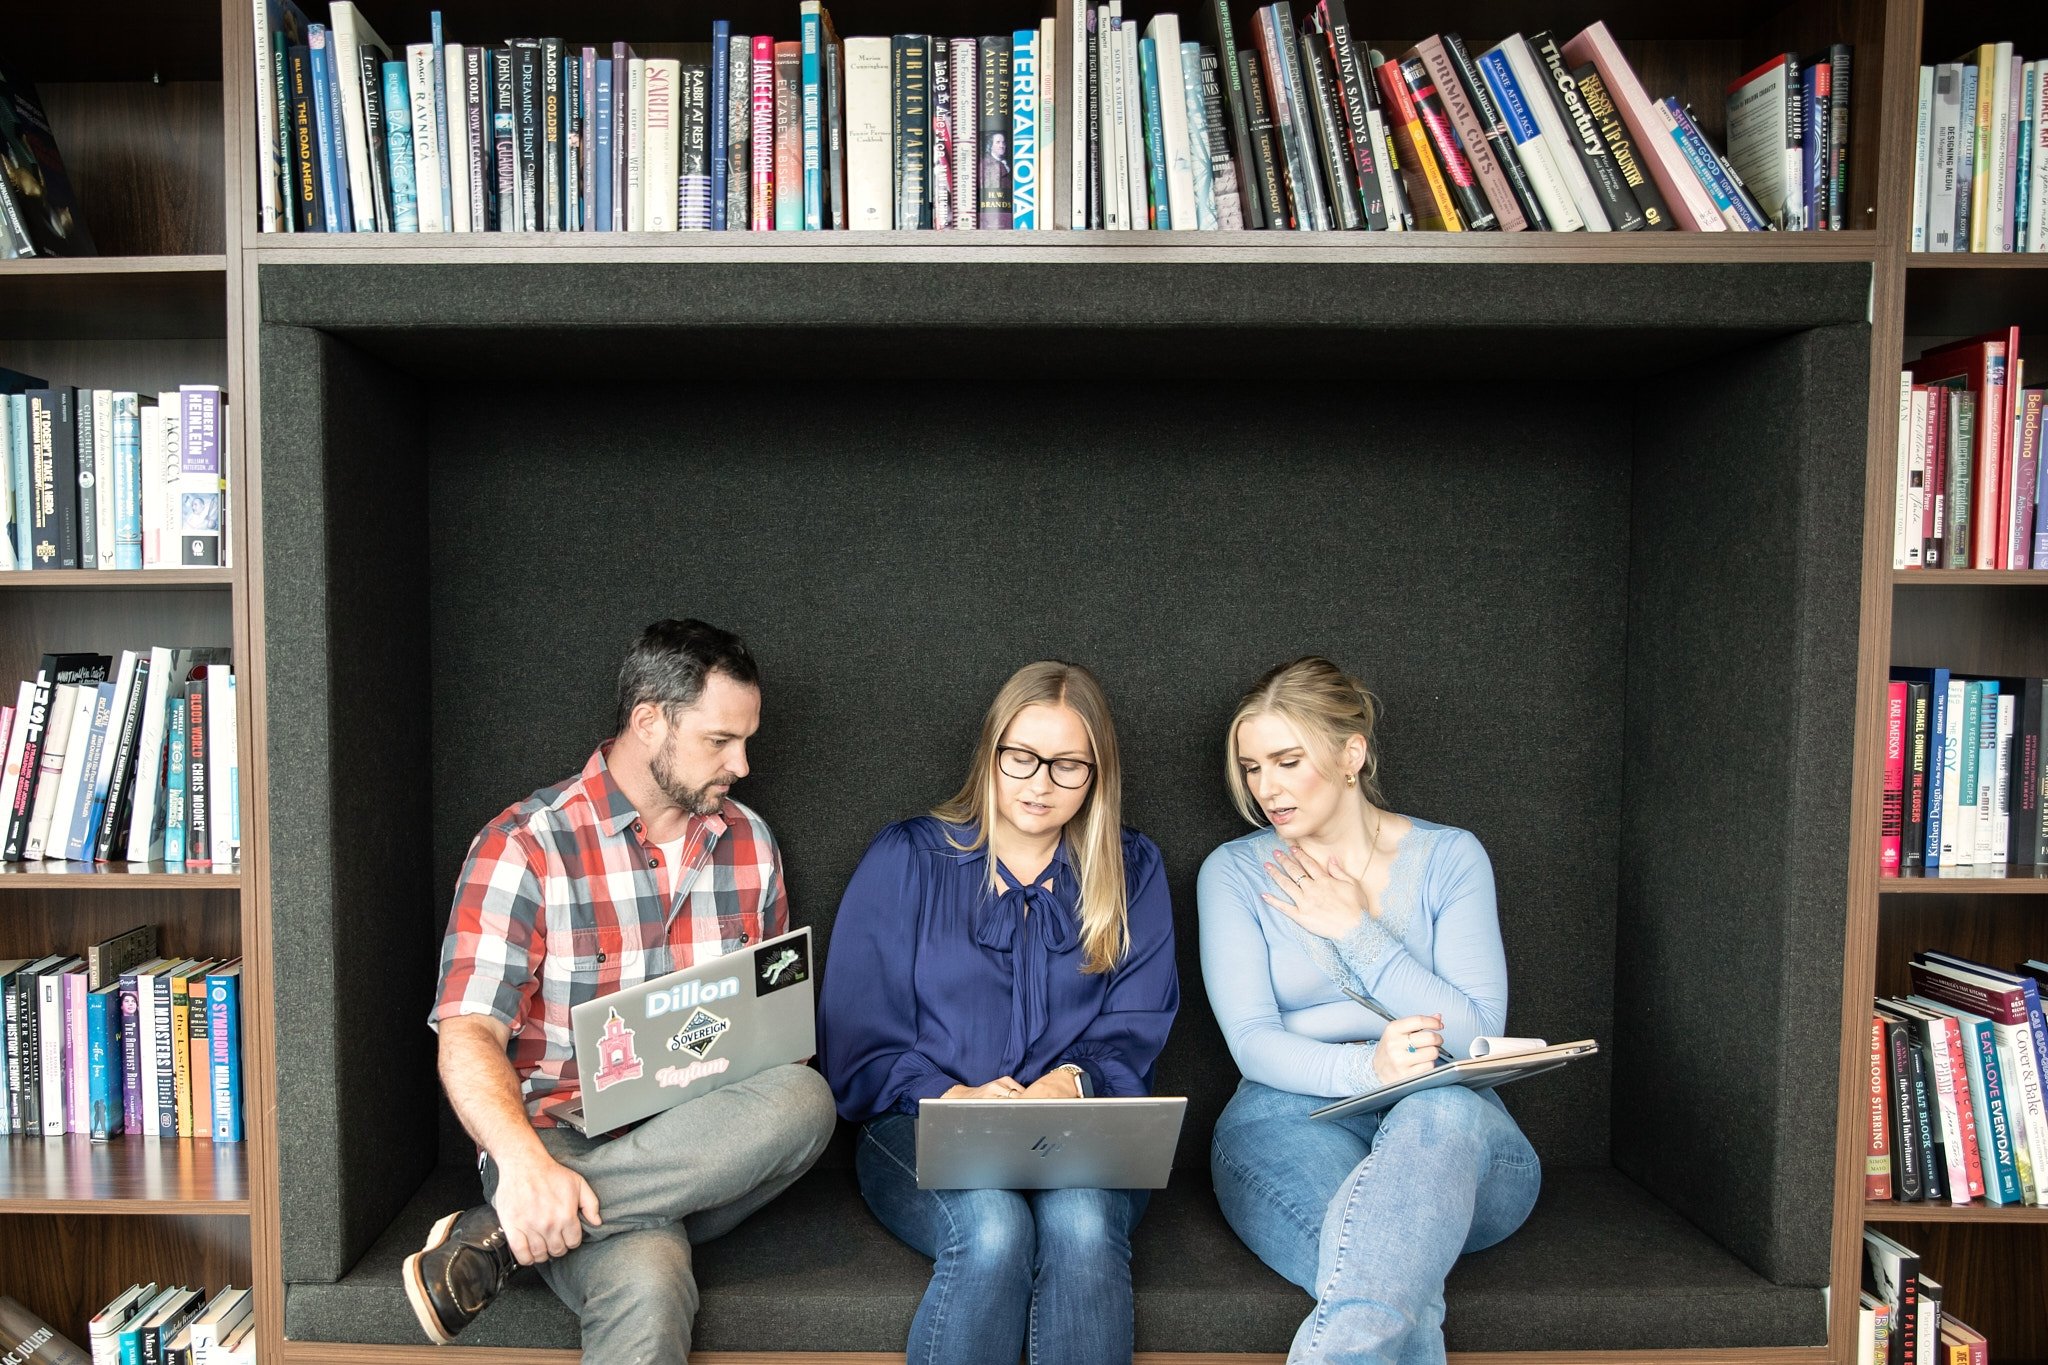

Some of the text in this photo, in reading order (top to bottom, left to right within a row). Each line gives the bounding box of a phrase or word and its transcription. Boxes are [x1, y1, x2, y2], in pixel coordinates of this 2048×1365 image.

[935, 61, 947, 90] Made
[1220, 1, 1240, 91] ORPHEUS DESCENDING
[294, 59, 303, 94] BILL GATES
[363, 56, 379, 128] Lev's Violin
[469, 55, 479, 103] BOB COLE
[497, 55, 511, 109] JOHN SAUL
[523, 65, 533, 123] DREAMING
[547, 45, 556, 142] ALMOST GOLDEN
[645, 68, 669, 128] SCARLETT
[986, 49, 995, 116] AMERICAN
[1000, 52, 1009, 115] THE FIRST
[1090, 83, 1096, 91] IN
[1248, 58, 1264, 115] THE SKEPTIC
[1335, 26, 1373, 174] EDWINA SANDYS ART
[1493, 59, 1534, 137] JACKIE AFTER JACK
[1541, 40, 1564, 79] The
[1557, 76, 1605, 156] Century
[1968, 75, 1977, 110] Pound
[573, 121, 578, 131] UP
[693, 70, 704, 151] RABBIT AT REST
[753, 59, 772, 172] JANET EVANOVICH
[806, 84, 818, 169] THE COMPLETE HOME OFFICE
[906, 48, 923, 206] DRIVEN PATRIOT
[935, 106, 947, 157] America
[1434, 55, 1494, 175] PRIMAL CUTS
[1793, 96, 1801, 139] BUILDING
[298, 102, 313, 201] THE ROAD AHEAD
[388, 109, 408, 216] RAGING SEA
[524, 128, 534, 160] HUNT
[777, 80, 788, 203] ELIZABETH BISHOP
[1672, 109, 1694, 136] SHIFT
[1691, 136, 1701, 147] for
[1697, 147, 1719, 176] GOOD
[1937, 138, 1946, 169] Moggridge
[1945, 126, 1955, 191] DESIGNING MEDIA
[1966, 131, 1974, 166] Pound
[961, 175, 969, 207] Brenner
[1260, 134, 1281, 213] TERRY TEACHOUT
[1718, 178, 1752, 224] TORY JOHNSON
[1961, 182, 1969, 217] SHANNON
[42, 411, 50, 419] IT
[189, 394, 202, 454] HEINLEIN
[203, 398, 213, 450] ROBERT A.
[1929, 392, 1937, 408] Small
[2023, 394, 2040, 457] Belladonna
[42, 421, 51, 457] DOESN'T
[167, 417, 180, 484] IACOCCA
[1955, 412, 1971, 522] Two American Presidents
[43, 460, 52, 482] TAKE
[45, 491, 54, 514] HERO
[2014, 496, 2026, 550] Anbara Salam
[1889, 699, 1901, 758] EARL EMERSON
[1969, 707, 1977, 724] BEST
[191, 694, 204, 831] BLOOD WORLD CHRIS MOONEY
[1912, 699, 1924, 823] MICHAEL CONNELLY THE CLOSERS
[1967, 727, 1976, 771] VEGETARIAN
[1966, 774, 1974, 803] RECIPES
[649, 978, 737, 1014] Dillon
[6, 995, 20, 1091] FAMILY HISTORY MEMORY
[155, 1007, 170, 1065] MONSTERS
[212, 1004, 230, 1119] SYMBIONT MIRA GRANT
[671, 1021, 727, 1051] SOVEREIGN
[23, 1043, 31, 1101] CRONKITE
[1871, 1054, 1883, 1149] BLOOD STIRRING
[1980, 1031, 2010, 1165] EAT LOVE EVERYDAY
[2016, 1030, 2039, 1115] Cover & Bake
[1900, 1079, 1914, 1173] the Oxford Inheritance
[1916, 1081, 1930, 1148] SALT BLOCK
[1906, 1279, 1915, 1304] TOM
[16, 1326, 54, 1359] JULIEN
